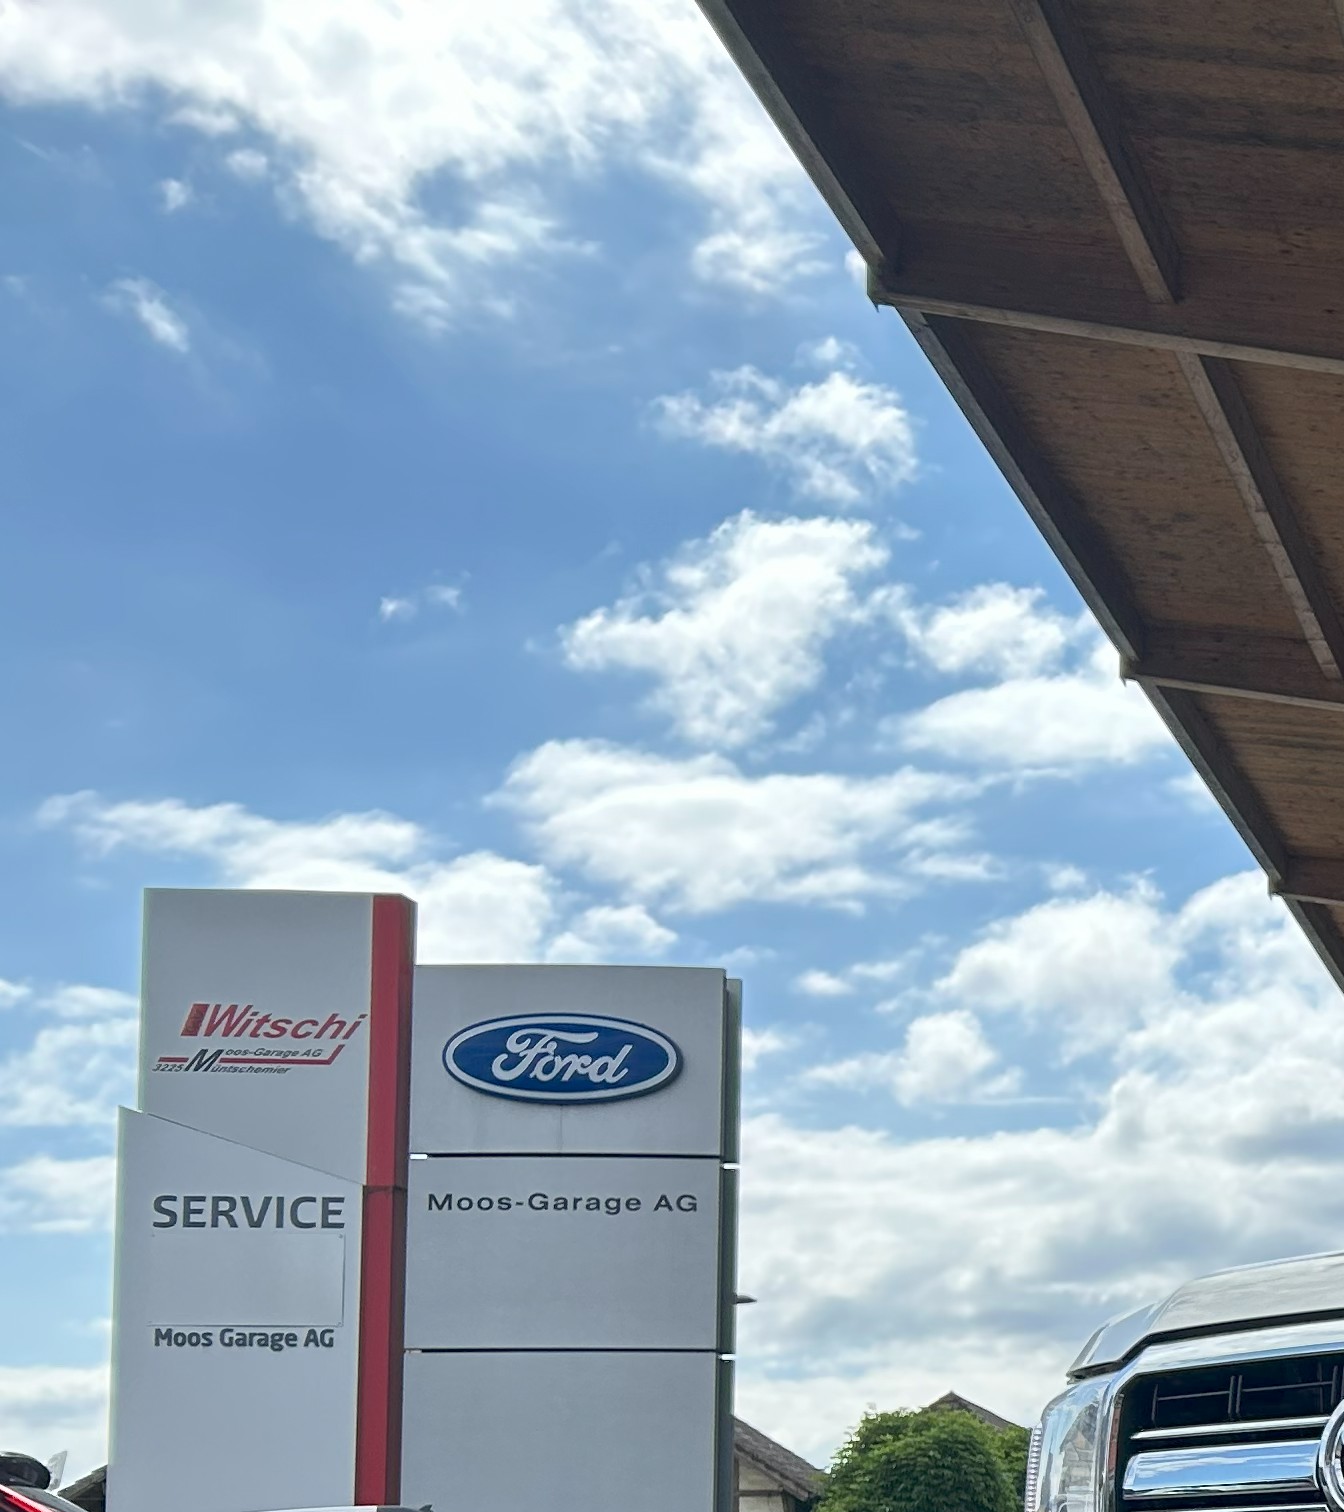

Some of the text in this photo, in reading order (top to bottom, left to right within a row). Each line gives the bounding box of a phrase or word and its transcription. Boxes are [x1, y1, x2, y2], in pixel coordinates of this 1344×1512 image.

[203, 1003, 368, 1040] Witschi
[302, 1048, 323, 1058] AG
[491, 1028, 633, 1084] Ford
[152, 1195, 345, 1229] SERVICE
[428, 1193, 698, 1215] Moos-Garage AG
[154, 1328, 335, 1352] Moos Garage AG
